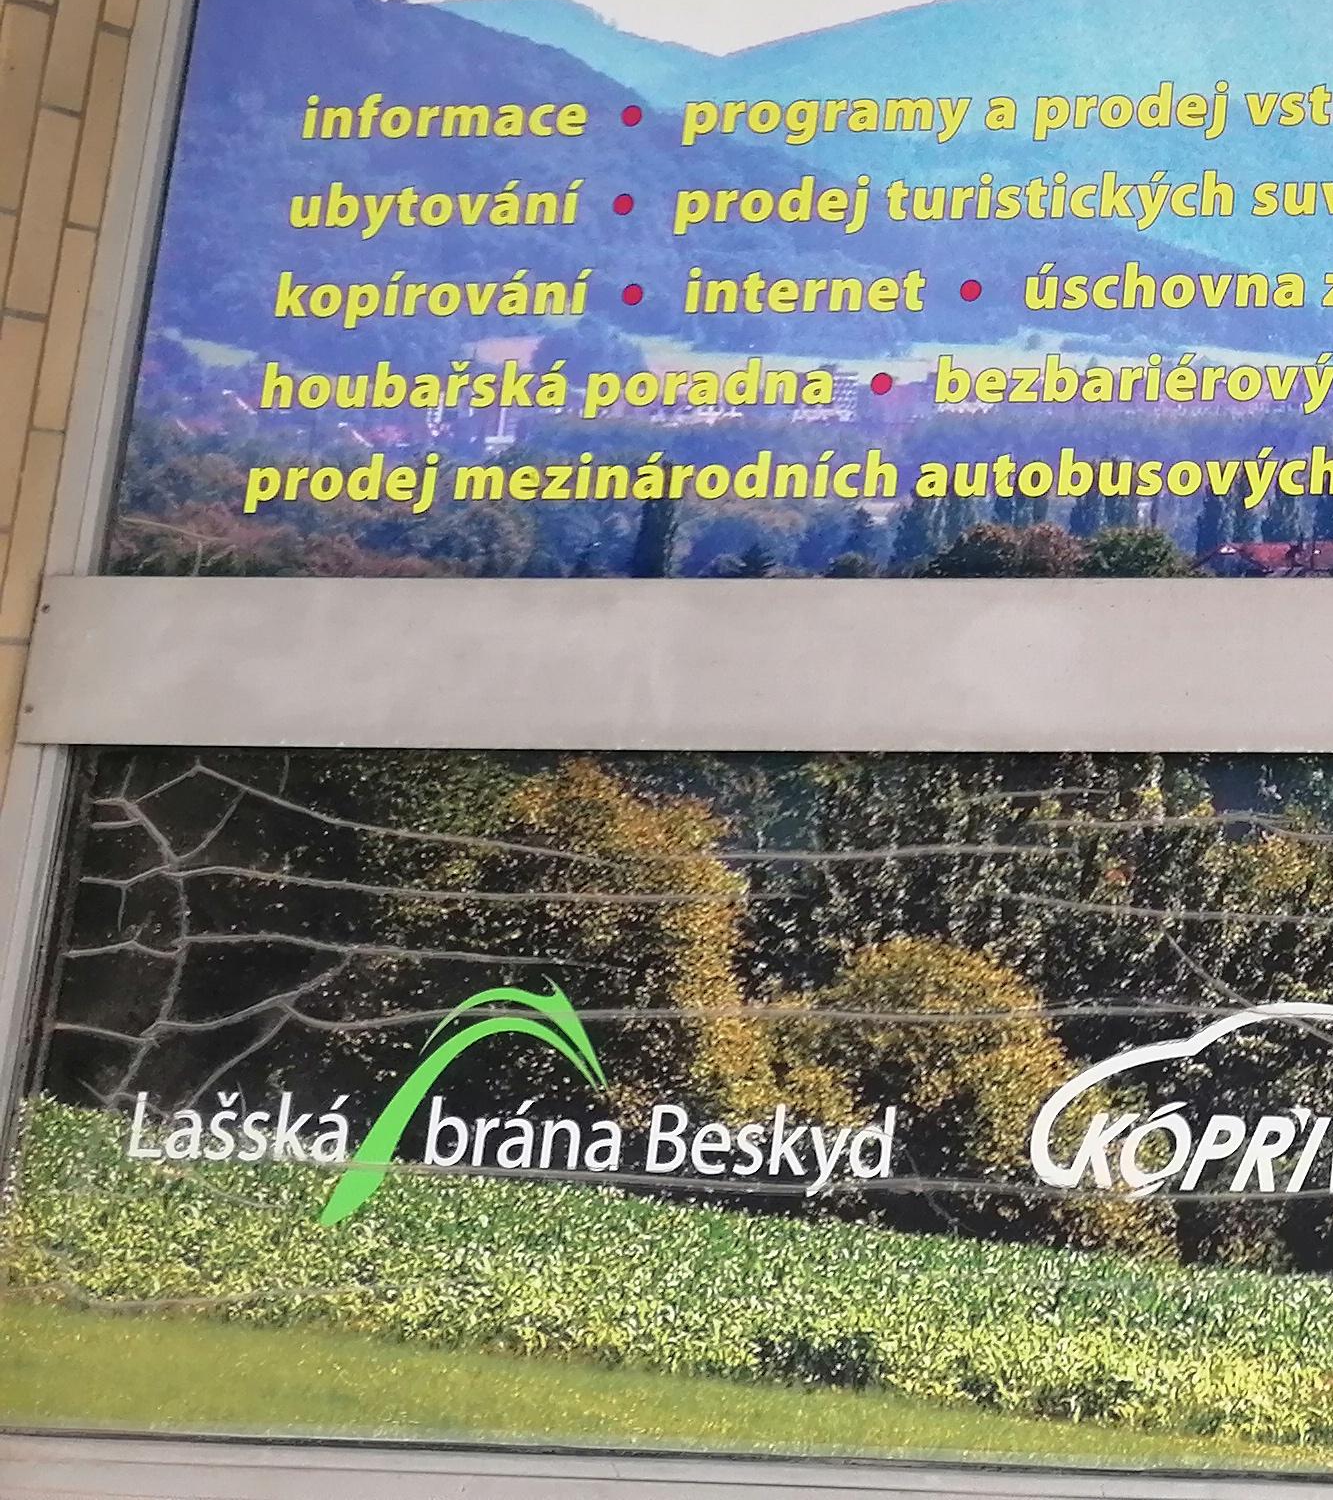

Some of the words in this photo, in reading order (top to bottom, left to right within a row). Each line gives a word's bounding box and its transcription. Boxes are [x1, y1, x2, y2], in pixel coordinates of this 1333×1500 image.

[301, 92, 587, 141] informace
[681, 94, 972, 146] programy
[984, 94, 1017, 131] a
[1032, 80, 1230, 141] prodej
[289, 178, 583, 239] ubytování
[674, 174, 872, 236] prodej
[887, 169, 1235, 230] turistických
[273, 269, 592, 330] kopírování
[683, 267, 927, 314] internet
[1024, 260, 1304, 311] úschovna
[260, 358, 567, 410] houbařská
[582, 356, 835, 419] poradna
[242, 453, 440, 514] prodej
[454, 448, 899, 501] mezinárodních
[126, 1091, 350, 1164] Lašská
[424, 1095, 621, 1172] brána
[645, 1103, 896, 1196] Beskyd
